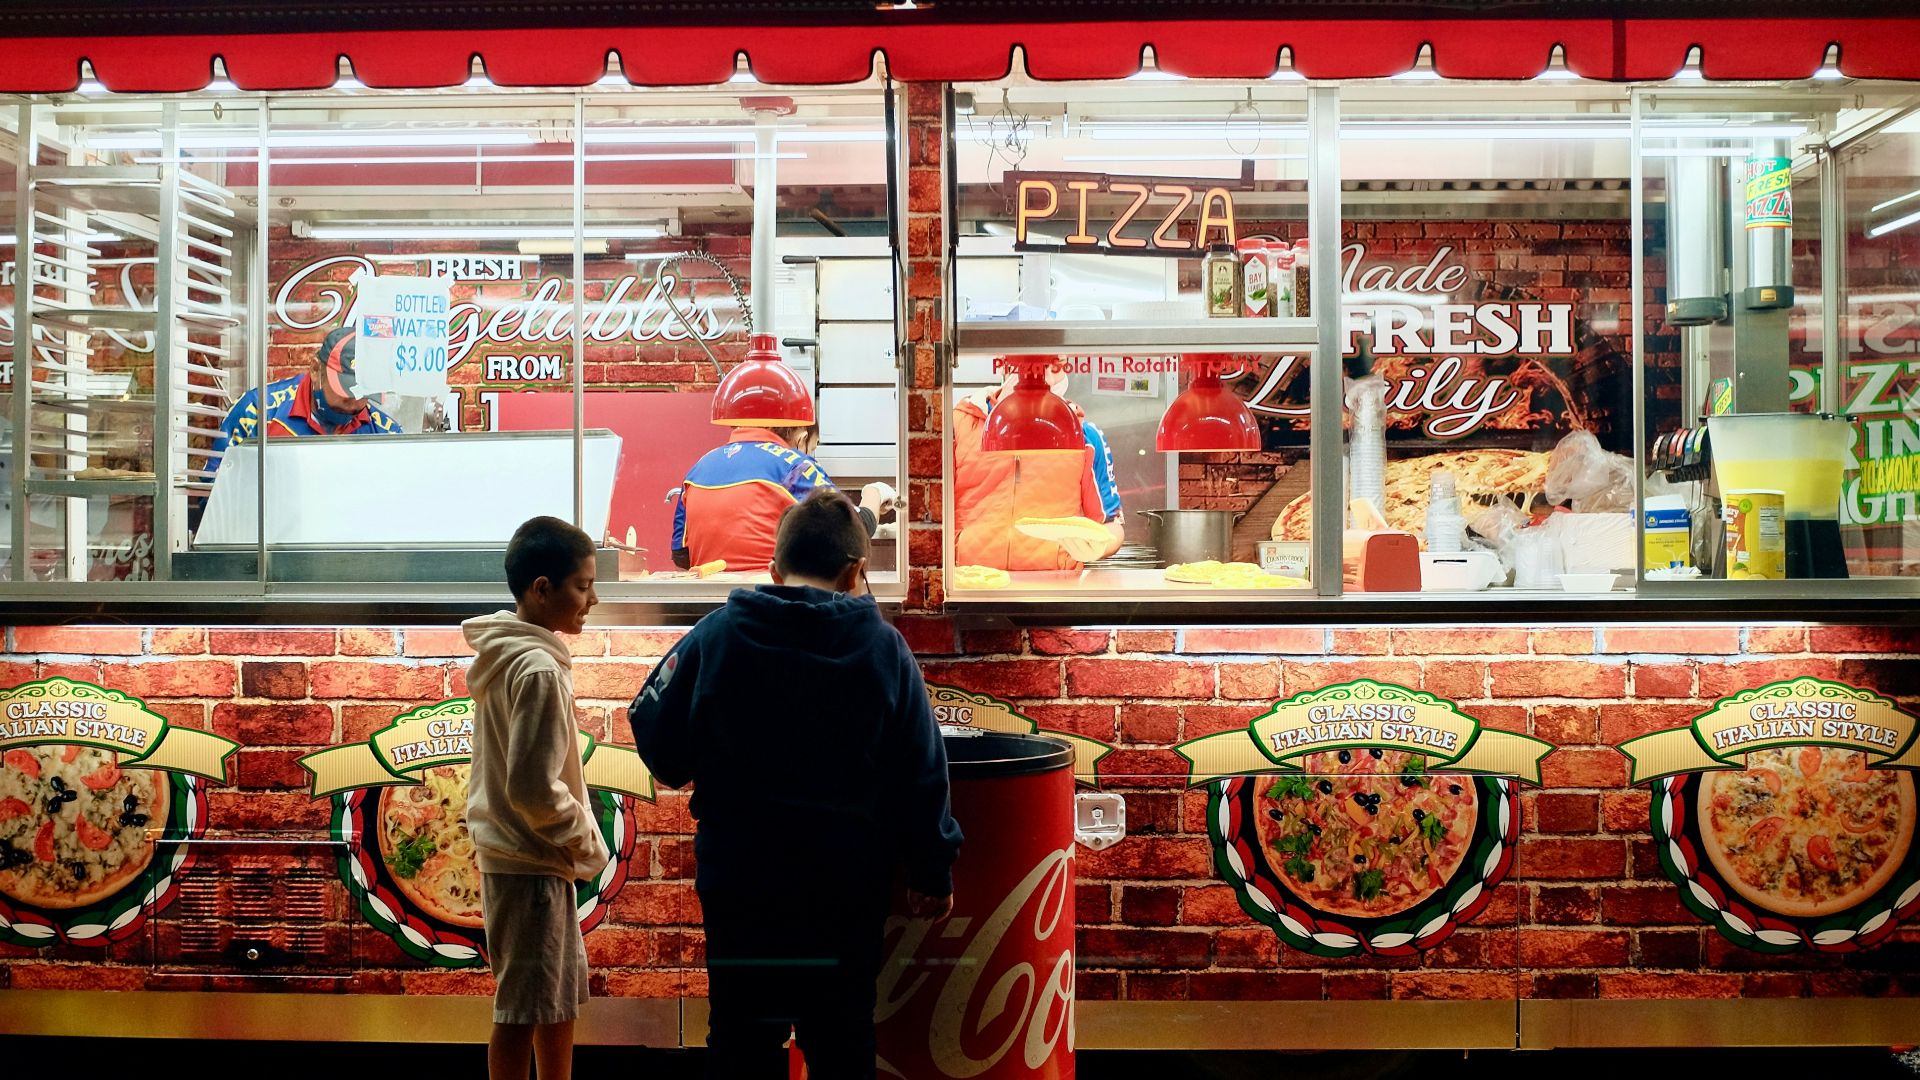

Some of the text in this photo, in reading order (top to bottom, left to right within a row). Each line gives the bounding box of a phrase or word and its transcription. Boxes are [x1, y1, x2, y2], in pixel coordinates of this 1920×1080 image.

[1746, 160, 1777, 180] HOT
[1747, 173, 1791, 197] FRESH
[1015, 179, 1237, 250] PIZZA
[1745, 190, 1792, 219] PIZZA
[429, 257, 523, 281] FRESH
[1248, 272, 1262, 284] BAY
[395, 294, 447, 314] BOTTLED
[392, 318, 447, 338] WATER
[1341, 303, 1574, 354] FRESH
[396, 342, 446, 376] $3.00
[486, 354, 563, 381] FROM
[992, 357, 1046, 375] Pizza
[1051, 356, 1091, 374] Sold
[1099, 356, 1115, 373] In
[1122, 356, 1204, 374] Rotation
[7, 701, 107, 721] CLASSIC
[1308, 703, 1417, 722] CLASSIC
[1749, 701, 1857, 721] CLASSIC
[74, 719, 147, 748] STYLE
[1271, 722, 1458, 753] ITALIAN STYLE
[1713, 720, 1898, 750] ITALIAN STYLE
